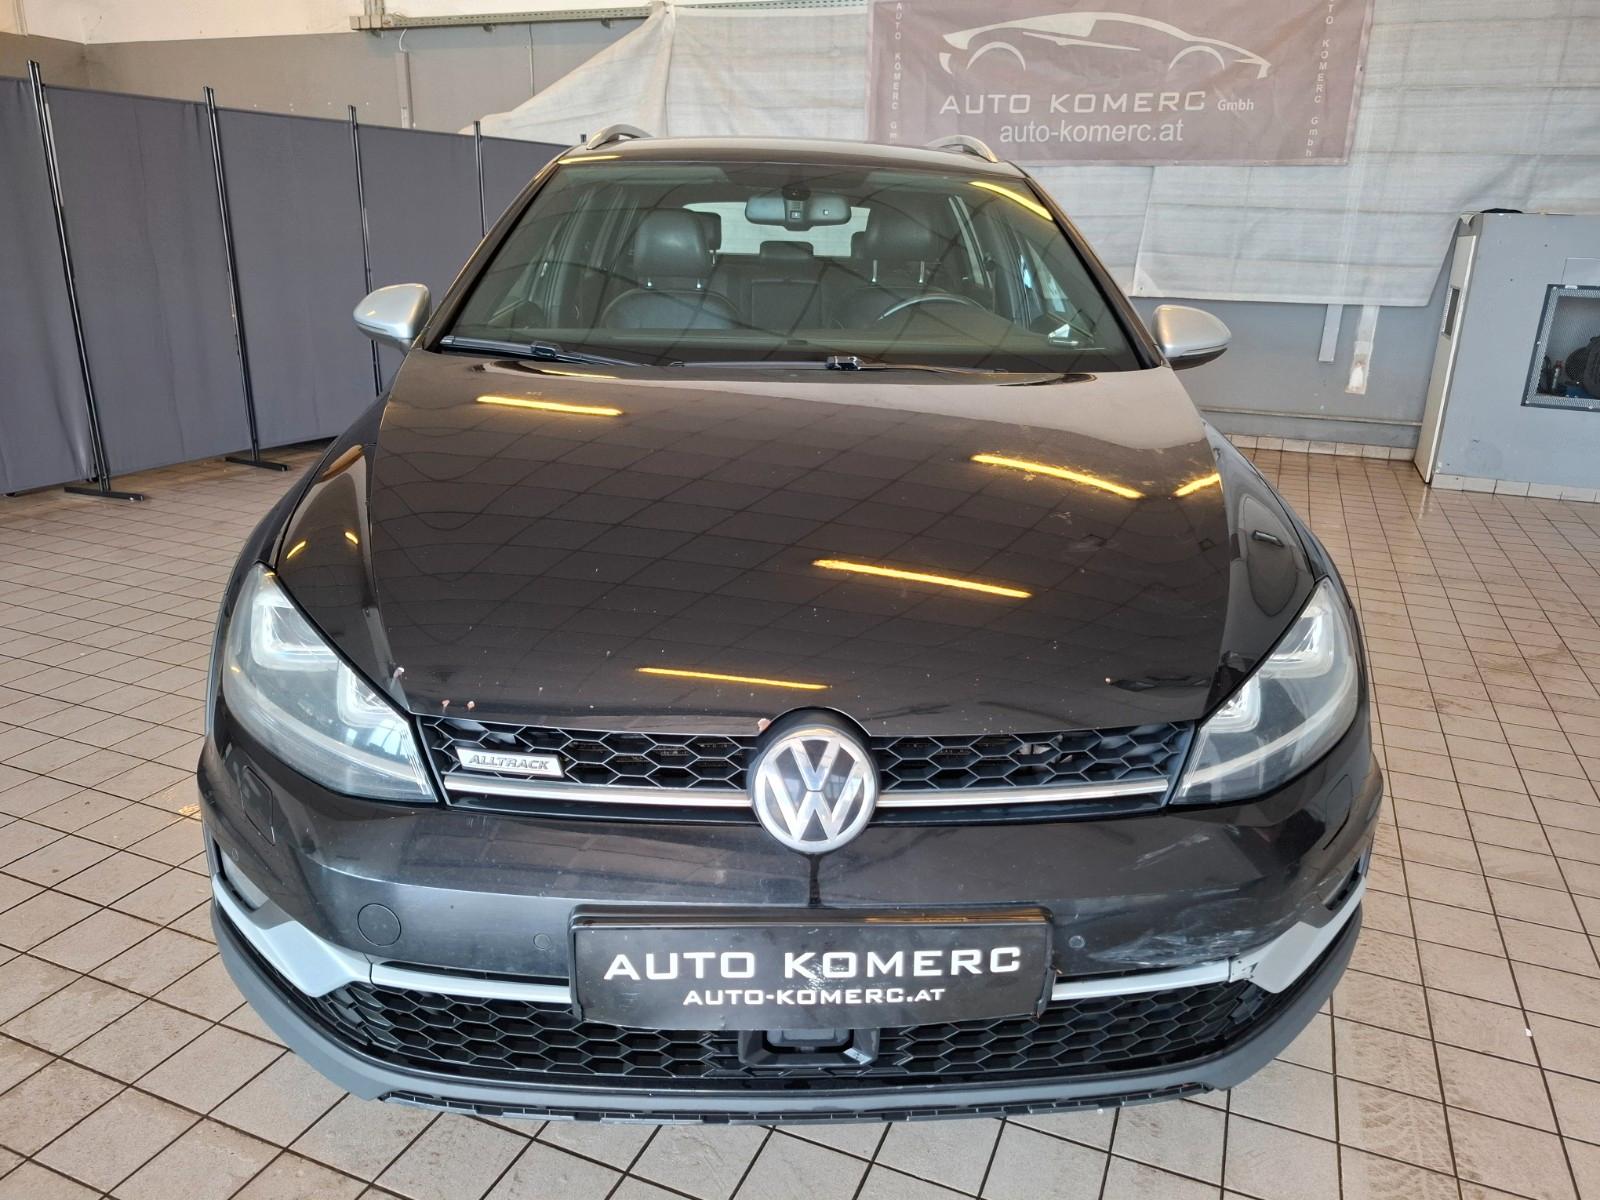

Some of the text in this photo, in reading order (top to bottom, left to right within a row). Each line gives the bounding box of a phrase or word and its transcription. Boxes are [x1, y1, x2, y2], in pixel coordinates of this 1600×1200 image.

[891, 53, 902, 110] KOMERC
[1314, 39, 1330, 104] KOMERC
[939, 91, 1255, 114] AUTO KOMERC Gmbh
[999, 118, 1184, 144] auto-komerc.at
[1305, 117, 1319, 157] Gmbh
[468, 754, 550, 770] ALLTRACK
[603, 946, 1022, 981] AUTO KOMERC
[682, 988, 946, 1006] AUTO-KOMERC.AT
